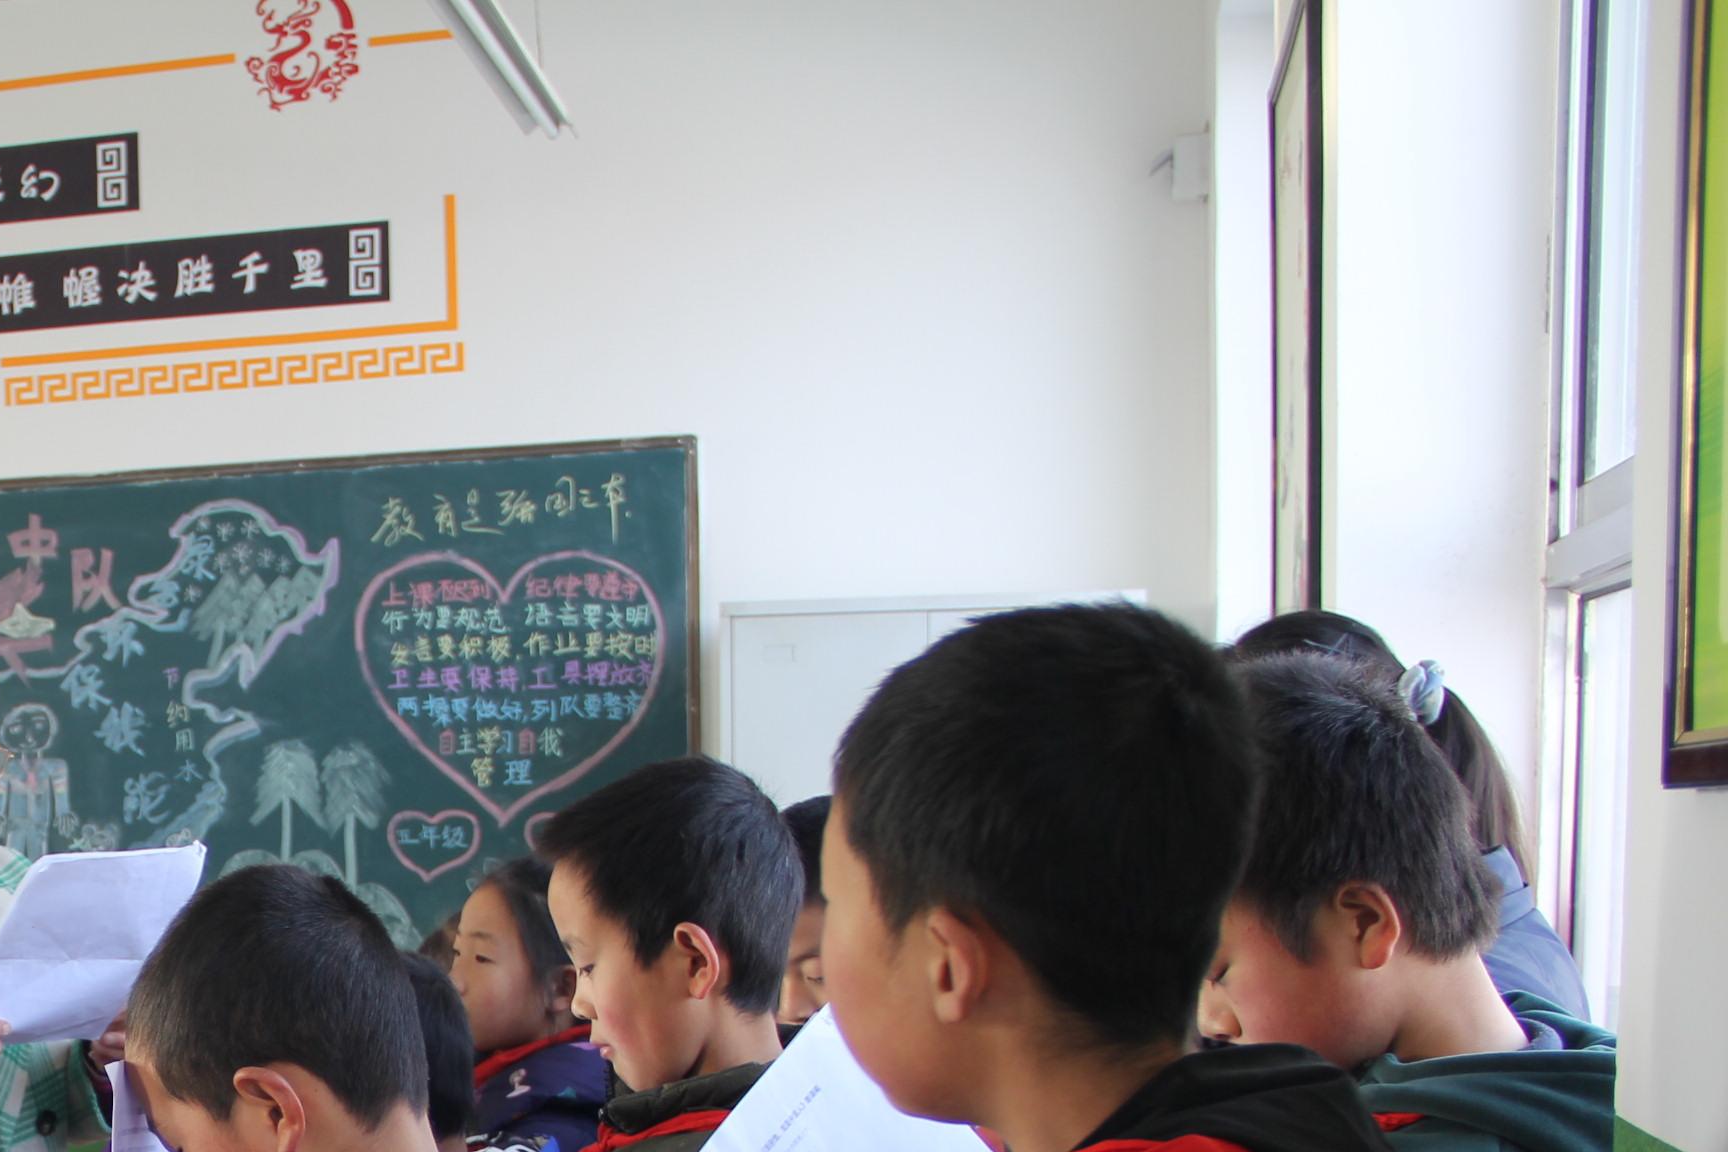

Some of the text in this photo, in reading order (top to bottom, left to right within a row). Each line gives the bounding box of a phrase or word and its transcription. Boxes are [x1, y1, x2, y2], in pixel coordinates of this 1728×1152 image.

[163, 667, 204, 782] 节约用水
[471, 757, 534, 788] 管理
